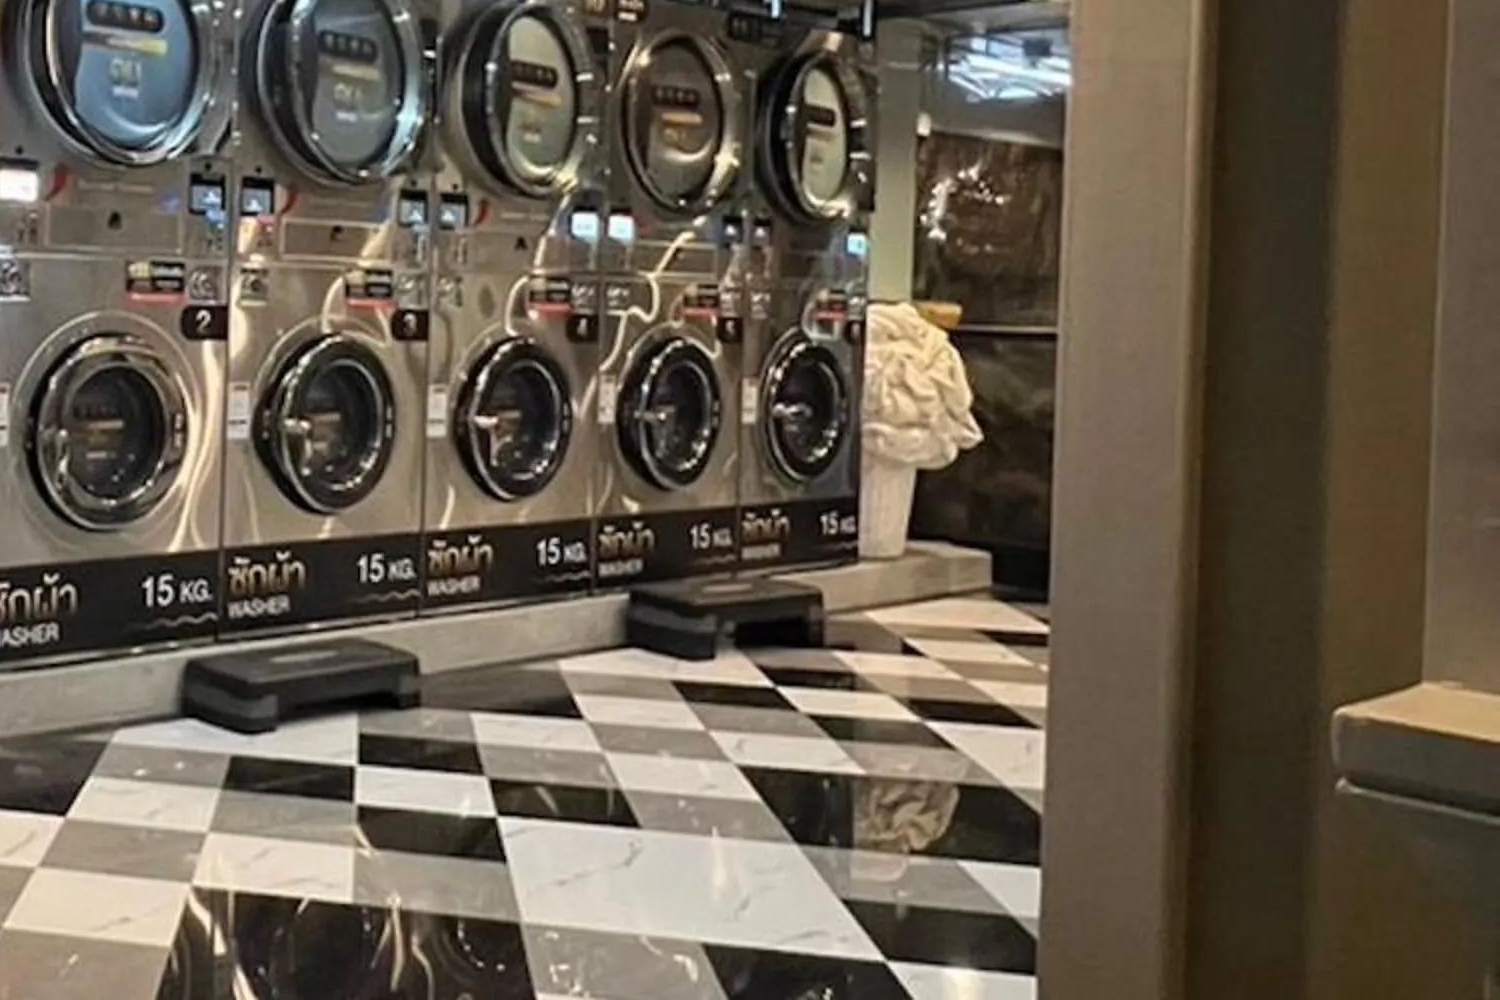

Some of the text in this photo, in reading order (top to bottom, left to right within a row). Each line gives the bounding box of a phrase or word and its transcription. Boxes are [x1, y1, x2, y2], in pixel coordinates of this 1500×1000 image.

[195, 310, 211, 331] 2
[820, 511, 839, 535] 15
[690, 523, 711, 550] 15
[536, 536, 561, 566] 15
[356, 554, 383, 583] 15
[141, 574, 174, 608] 15
[427, 576, 481, 598] WASHER
[227, 597, 291, 619] WASHER
